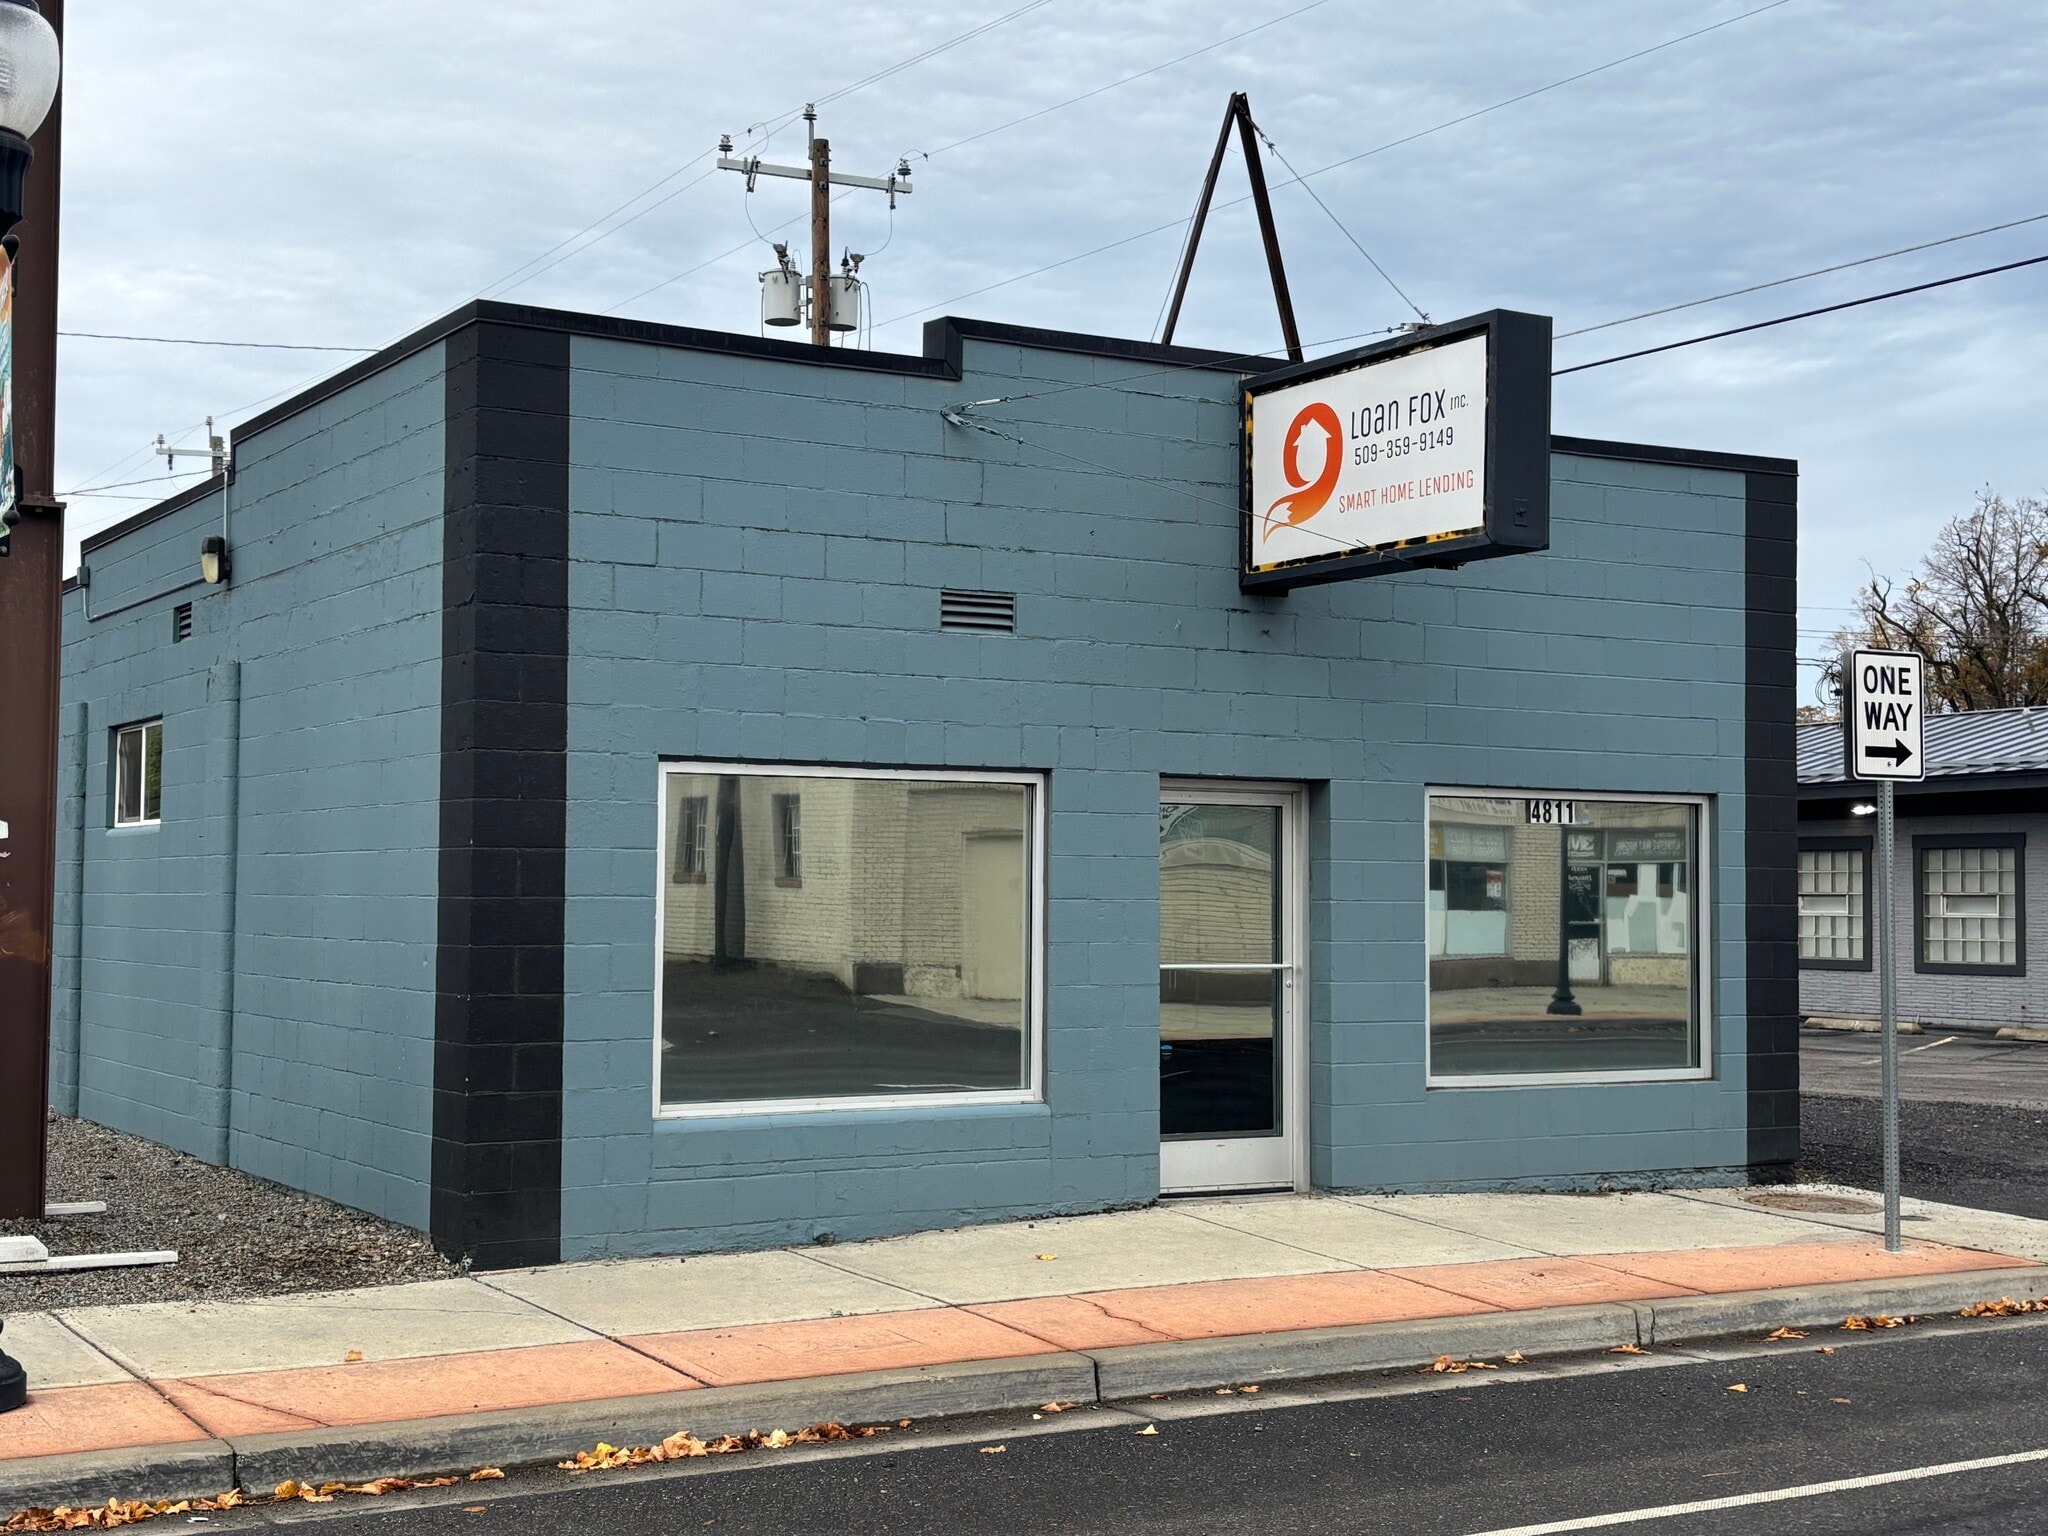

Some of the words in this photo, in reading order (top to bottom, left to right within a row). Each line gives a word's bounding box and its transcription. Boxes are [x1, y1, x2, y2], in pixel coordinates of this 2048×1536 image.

[1354, 426, 1454, 466] 509-359-9149
[1339, 489, 1377, 514] SMART
[1381, 481, 1414, 505] HOME
[1419, 469, 1474, 497] LENDING
[1863, 664, 1912, 695] ONE
[1864, 701, 1913, 731] WAY
[1531, 800, 1573, 823] 4811
